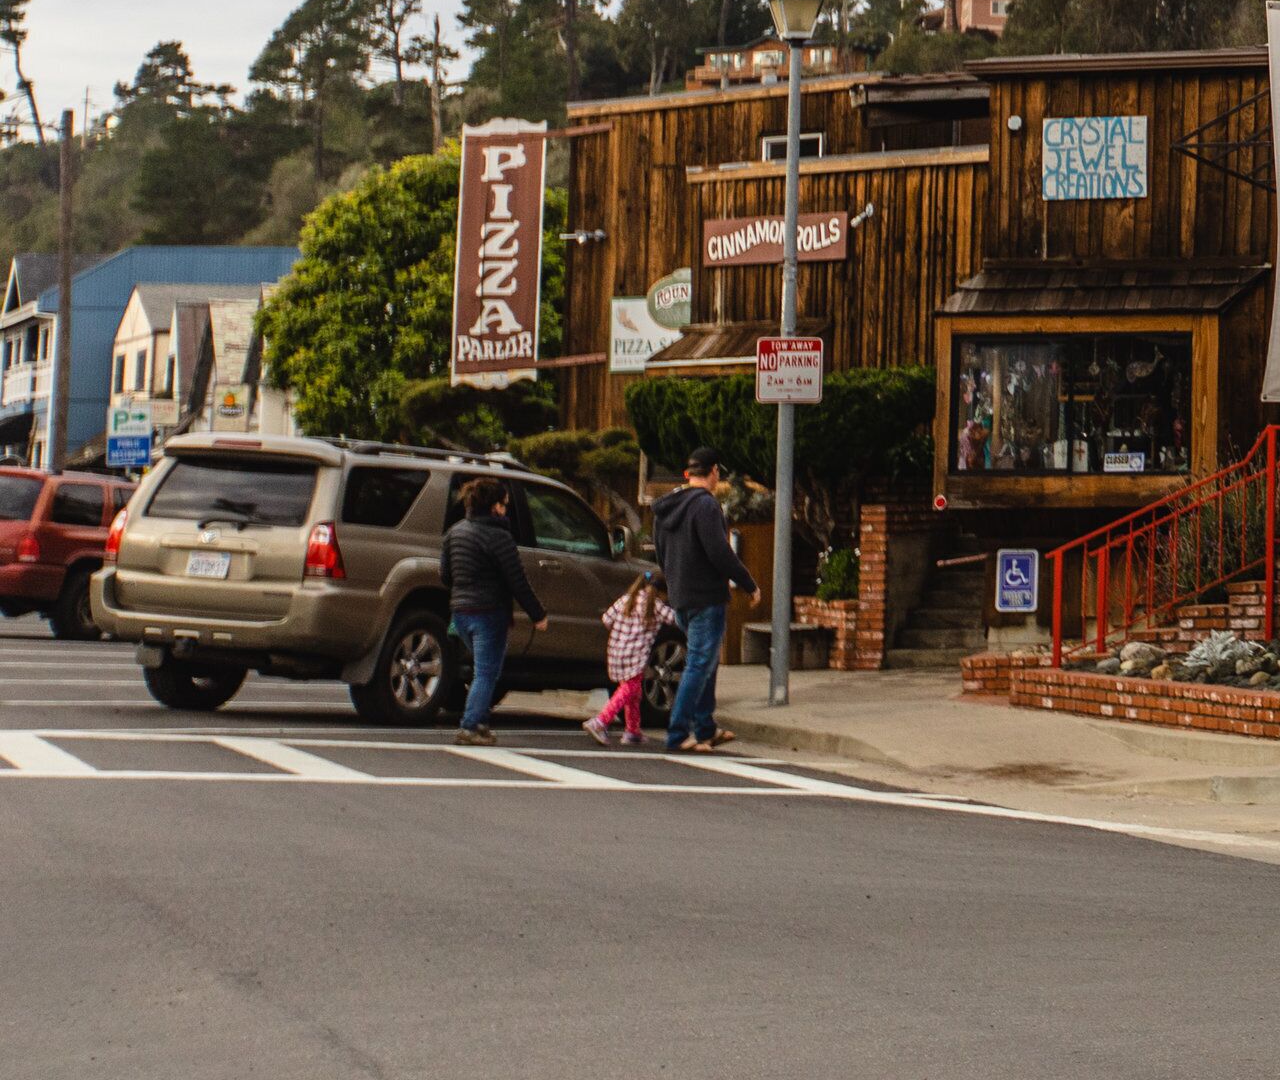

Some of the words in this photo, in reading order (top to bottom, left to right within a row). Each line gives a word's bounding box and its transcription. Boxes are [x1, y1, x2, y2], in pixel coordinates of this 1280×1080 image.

[1044, 116, 1144, 146] CRYSTAL
[1046, 143, 1139, 173] JEWEL
[1043, 168, 1144, 199] CREATIONS
[469, 143, 527, 335] PIZZA
[656, 286, 689, 306] ROUN
[457, 331, 534, 361] PARLOR
[614, 337, 652, 354] PIZZA
[760, 352, 777, 370] NO
[779, 354, 818, 369] PARKING
